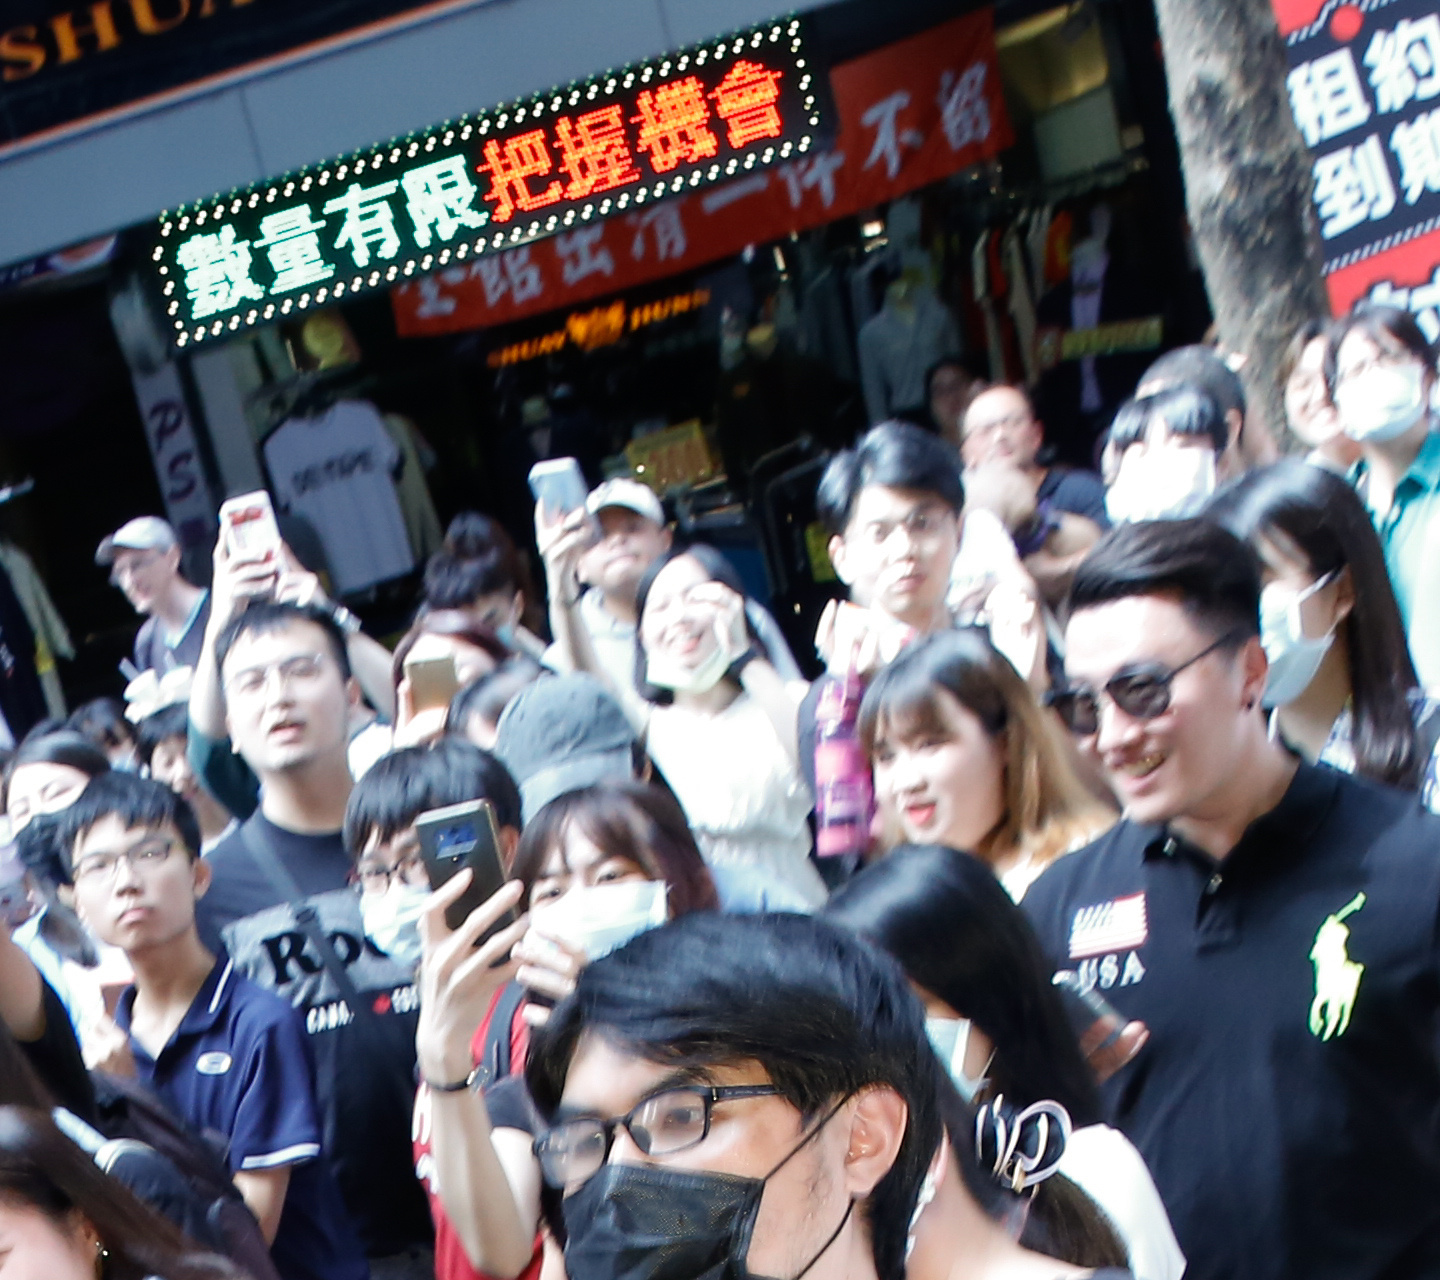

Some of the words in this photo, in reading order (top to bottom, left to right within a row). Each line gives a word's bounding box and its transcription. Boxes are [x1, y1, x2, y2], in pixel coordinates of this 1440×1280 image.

[176, 60, 783, 321] 數量有限把握機會
[1077, 950, 1147, 998] USA
